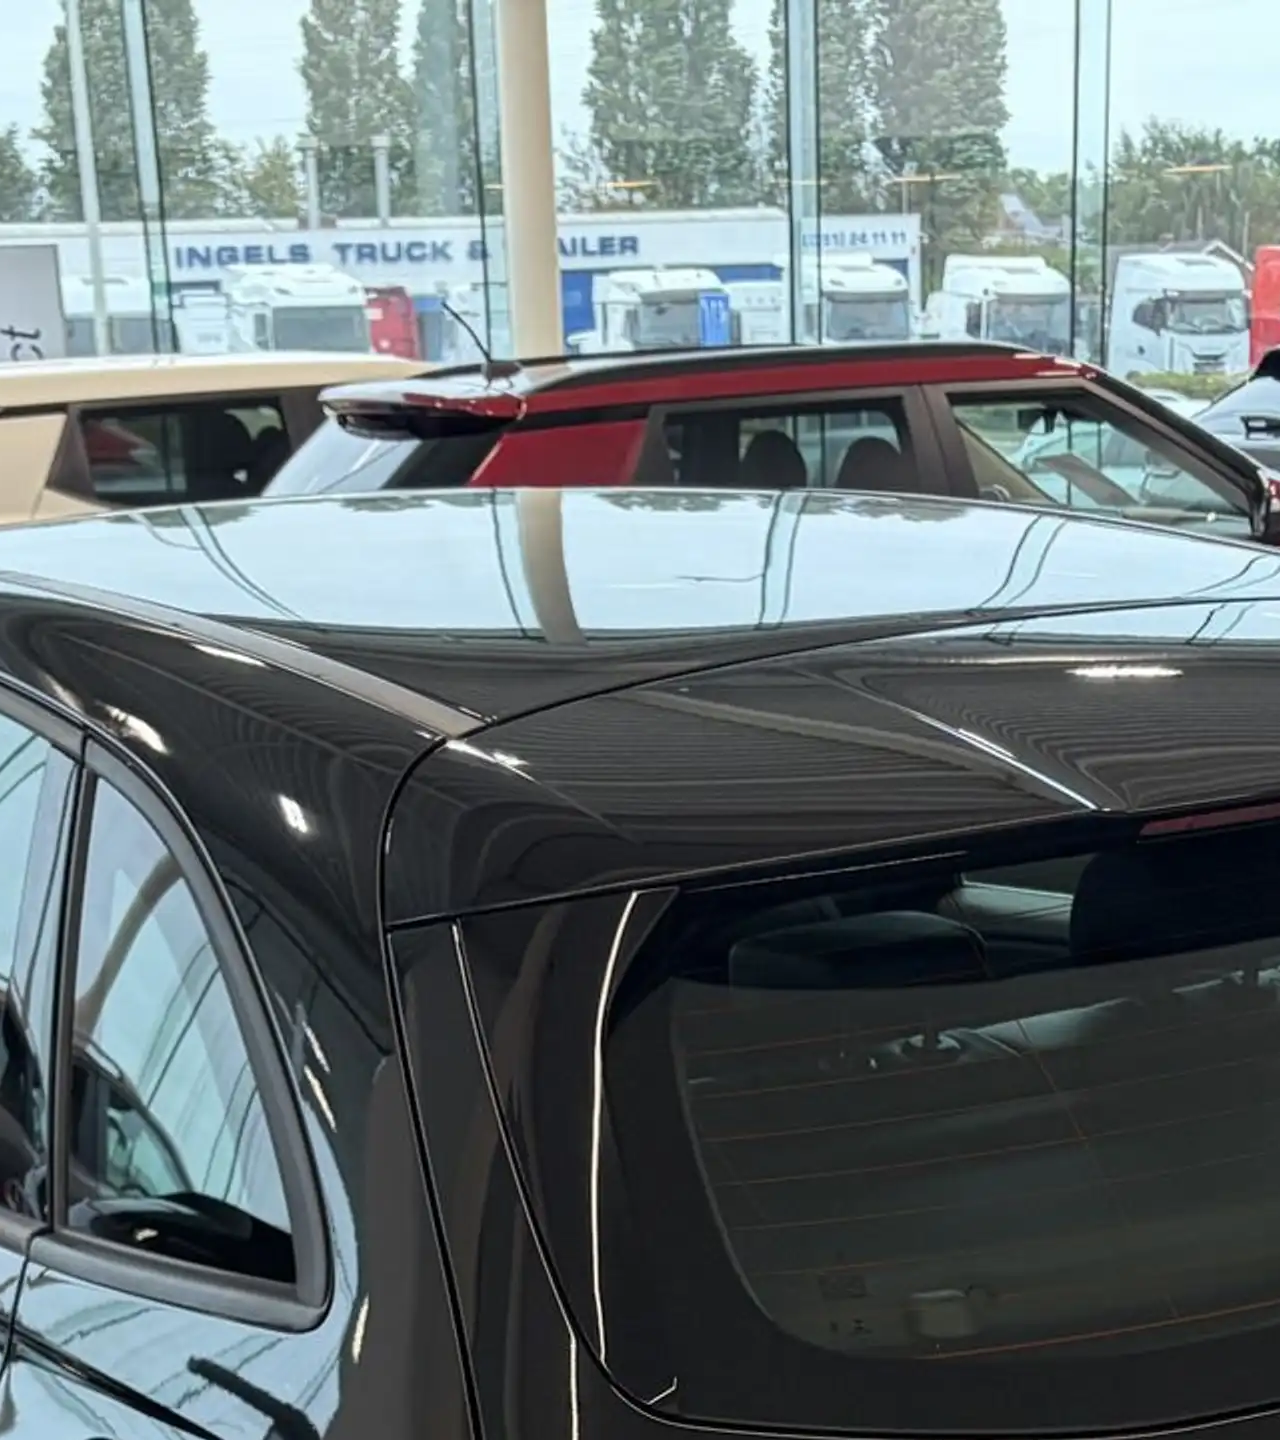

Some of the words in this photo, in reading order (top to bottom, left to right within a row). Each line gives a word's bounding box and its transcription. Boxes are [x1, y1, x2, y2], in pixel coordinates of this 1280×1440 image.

[175, 244, 312, 268] INGELS
[332, 239, 454, 264] TRUCK
[467, 240, 491, 261] &
